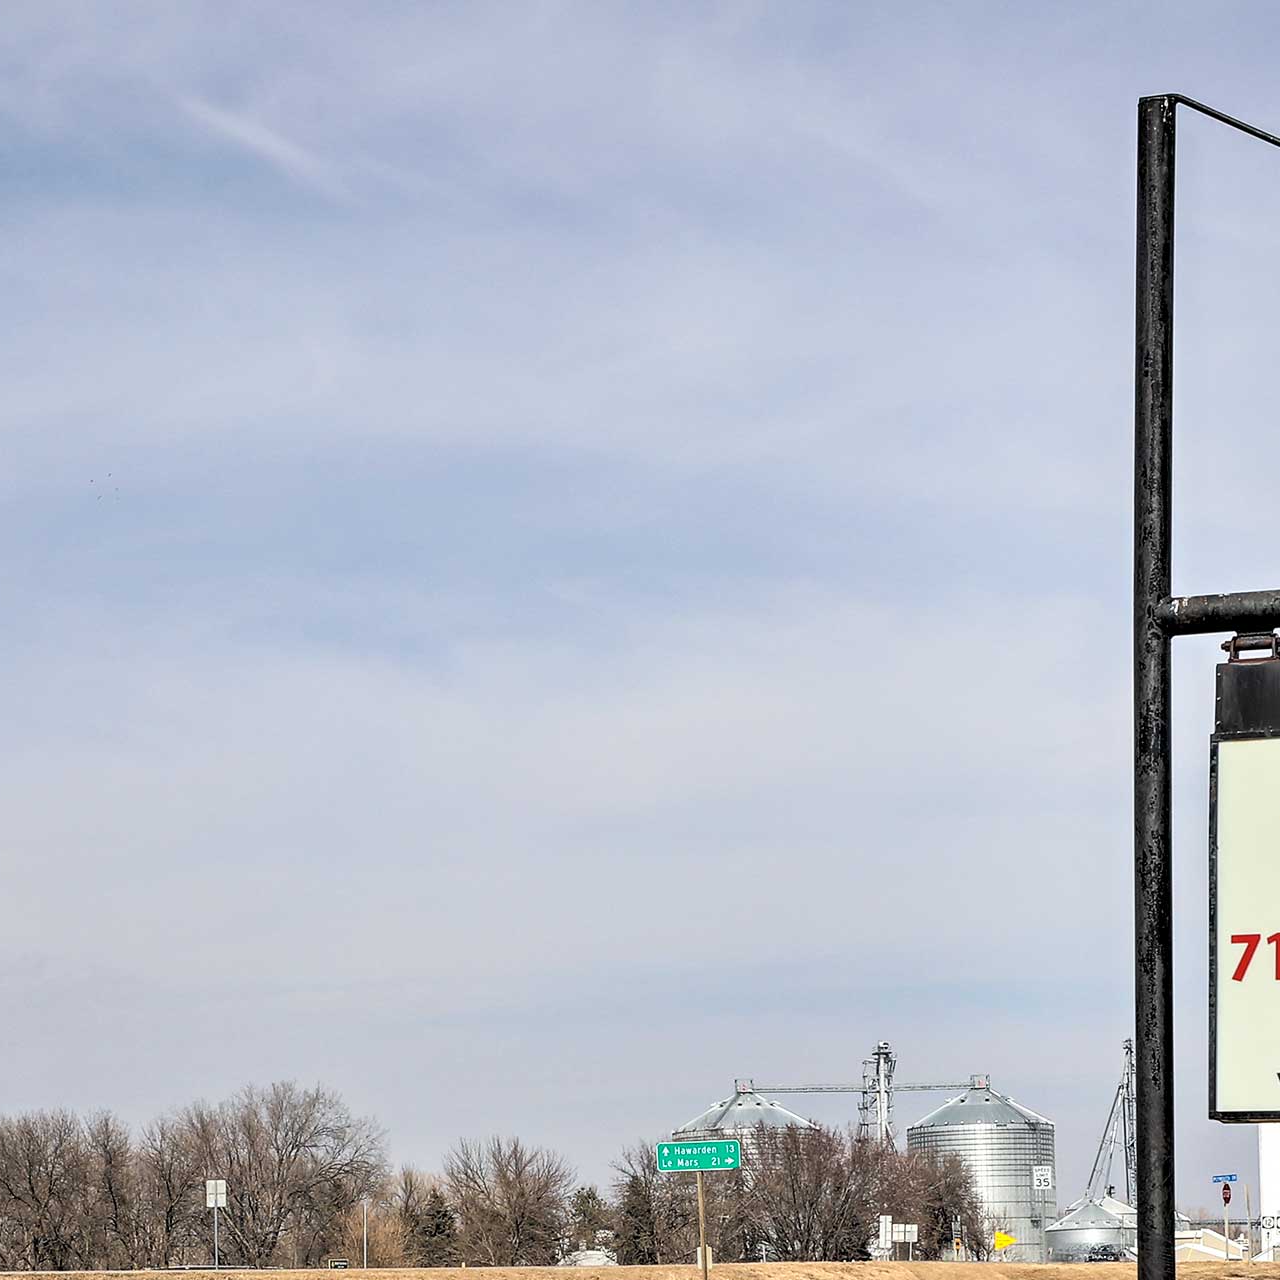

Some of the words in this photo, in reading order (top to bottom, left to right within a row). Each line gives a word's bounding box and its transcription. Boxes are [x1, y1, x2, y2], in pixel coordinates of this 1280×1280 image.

[674, 1146, 717, 1155] Hawarden
[725, 1144, 735, 1153] 13
[662, 1159, 673, 1168] Le
[711, 1157, 720, 1166] 21
[1035, 1177, 1050, 1187] 35
